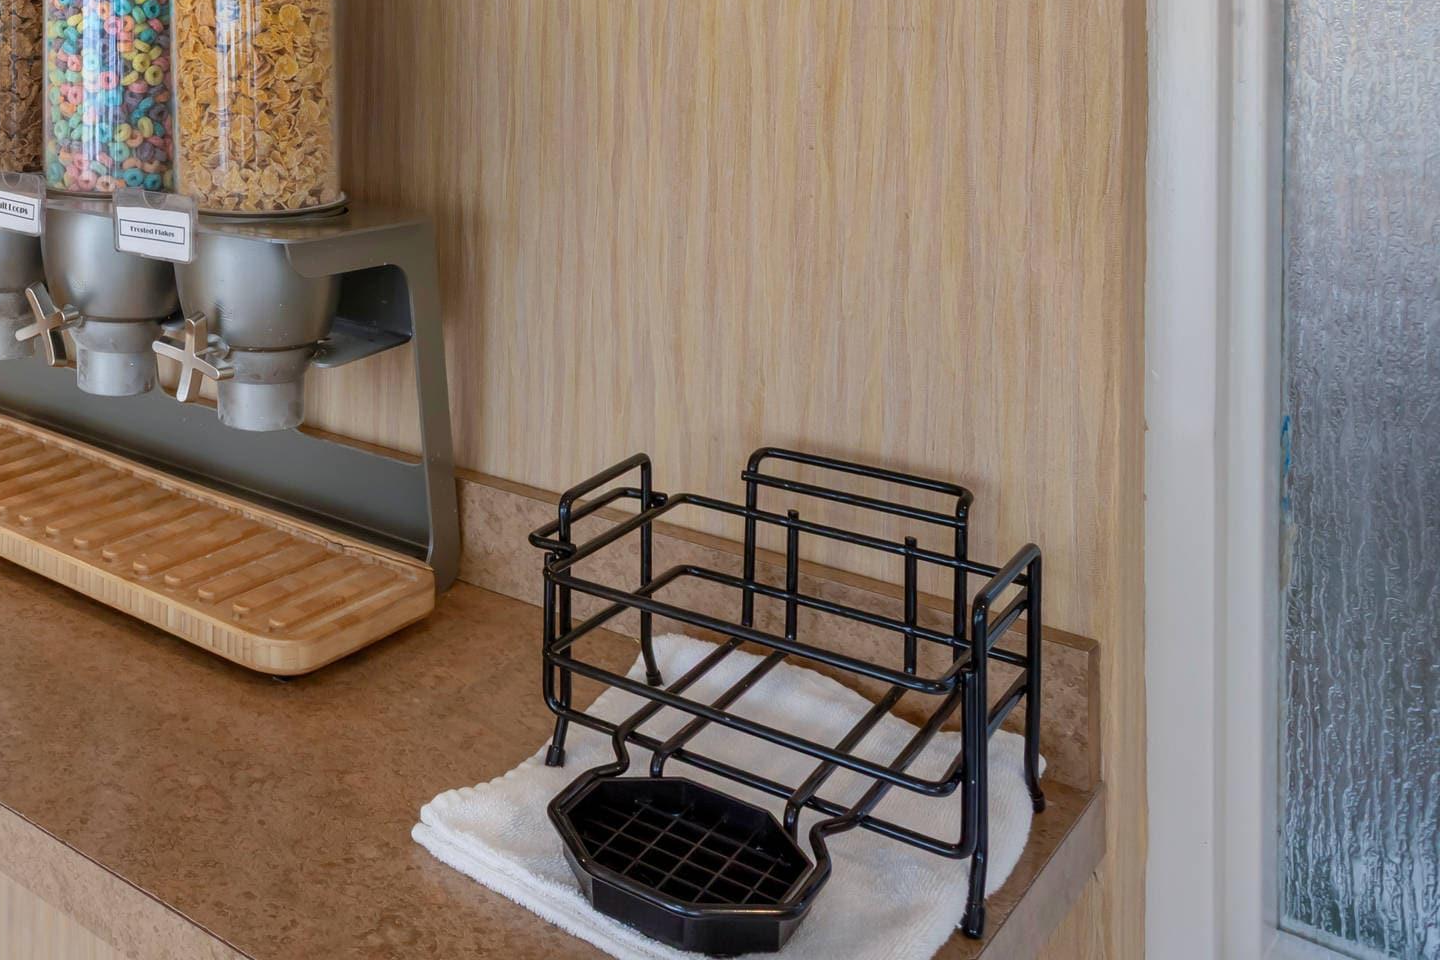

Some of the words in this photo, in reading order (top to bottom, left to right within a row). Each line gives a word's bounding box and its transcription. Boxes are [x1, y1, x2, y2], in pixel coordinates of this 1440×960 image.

[8, 203, 29, 215] Loops
[130, 225, 154, 235] Frosted
[154, 228, 175, 238] Flakes
